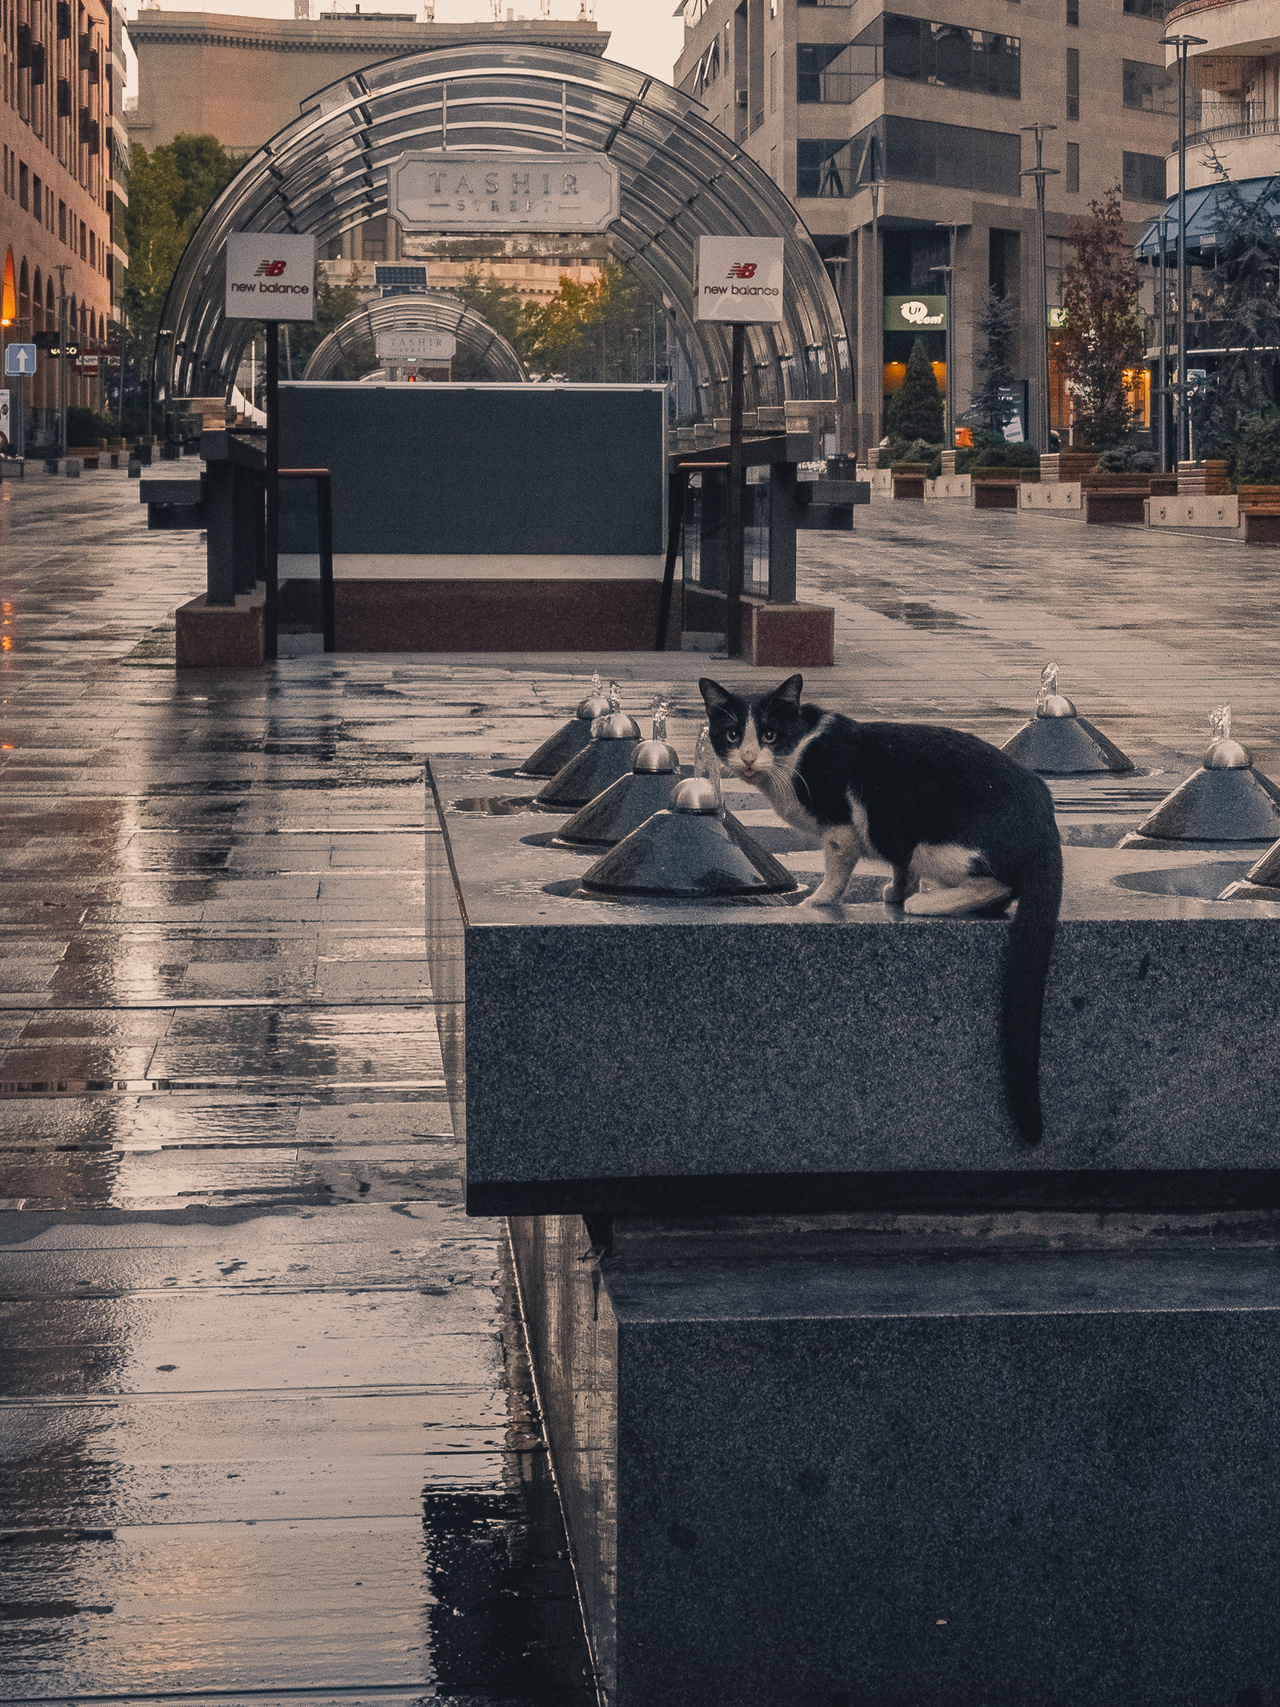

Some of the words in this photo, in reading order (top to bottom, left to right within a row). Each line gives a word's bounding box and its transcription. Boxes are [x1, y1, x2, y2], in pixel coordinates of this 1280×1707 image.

[428, 171, 579, 196] TASHIR
[457, 199, 553, 213] STREET
[231, 282, 256, 293] new
[259, 282, 310, 294] balance
[704, 285, 728, 295] new
[731, 284, 780, 296] balance
